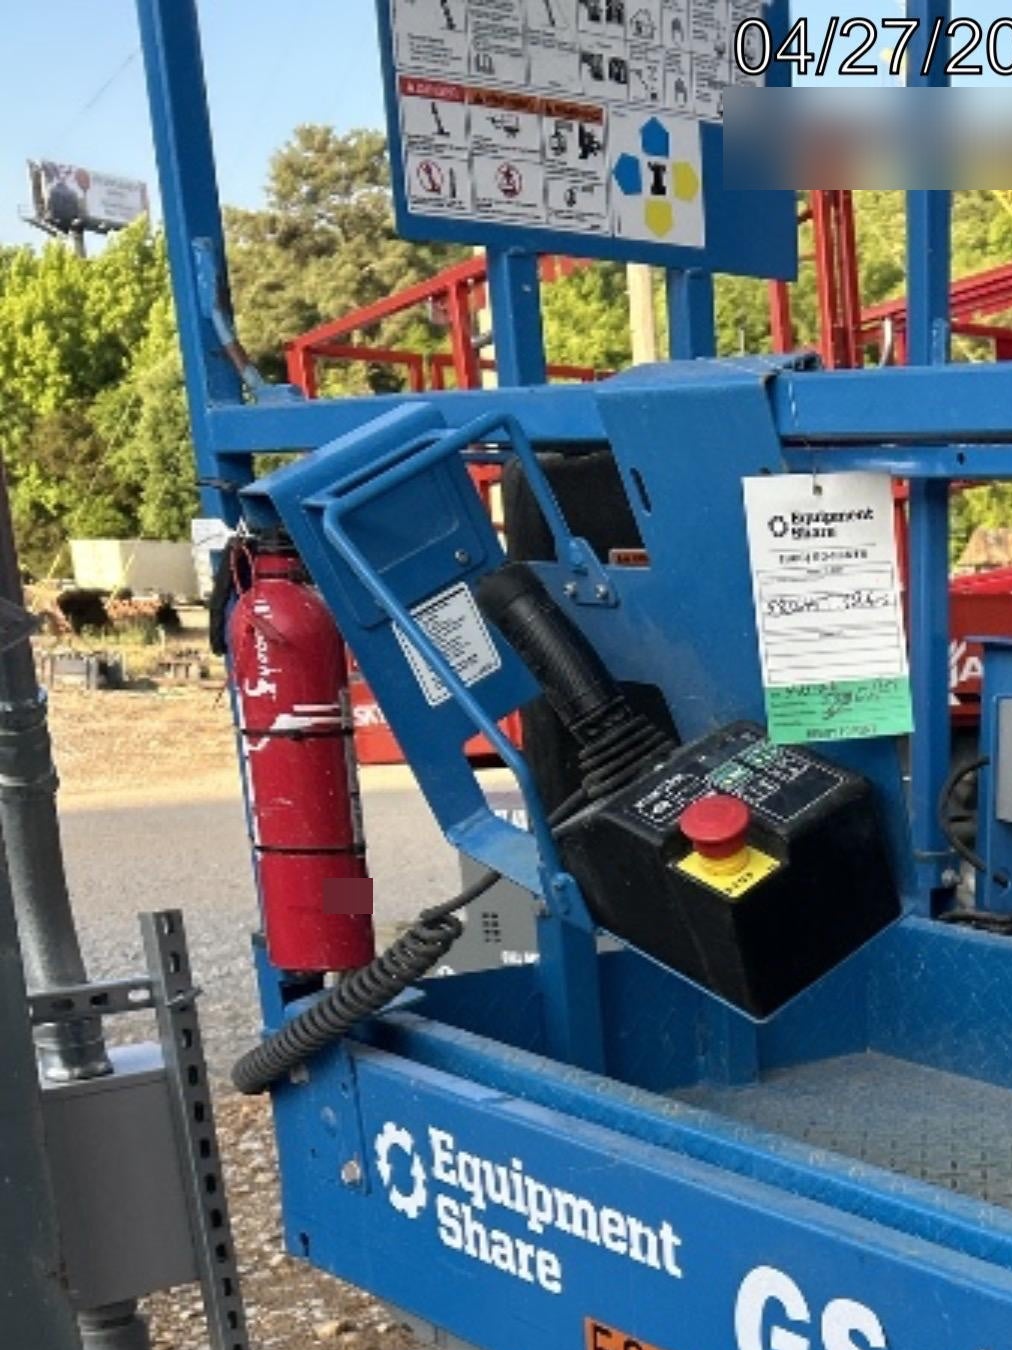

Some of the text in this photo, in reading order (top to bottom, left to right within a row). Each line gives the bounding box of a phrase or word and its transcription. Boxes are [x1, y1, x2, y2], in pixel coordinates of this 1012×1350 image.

[790, 507, 875, 526] Equipment
[428, 1125, 683, 1279] Equipment
[436, 1193, 563, 1295] Share
